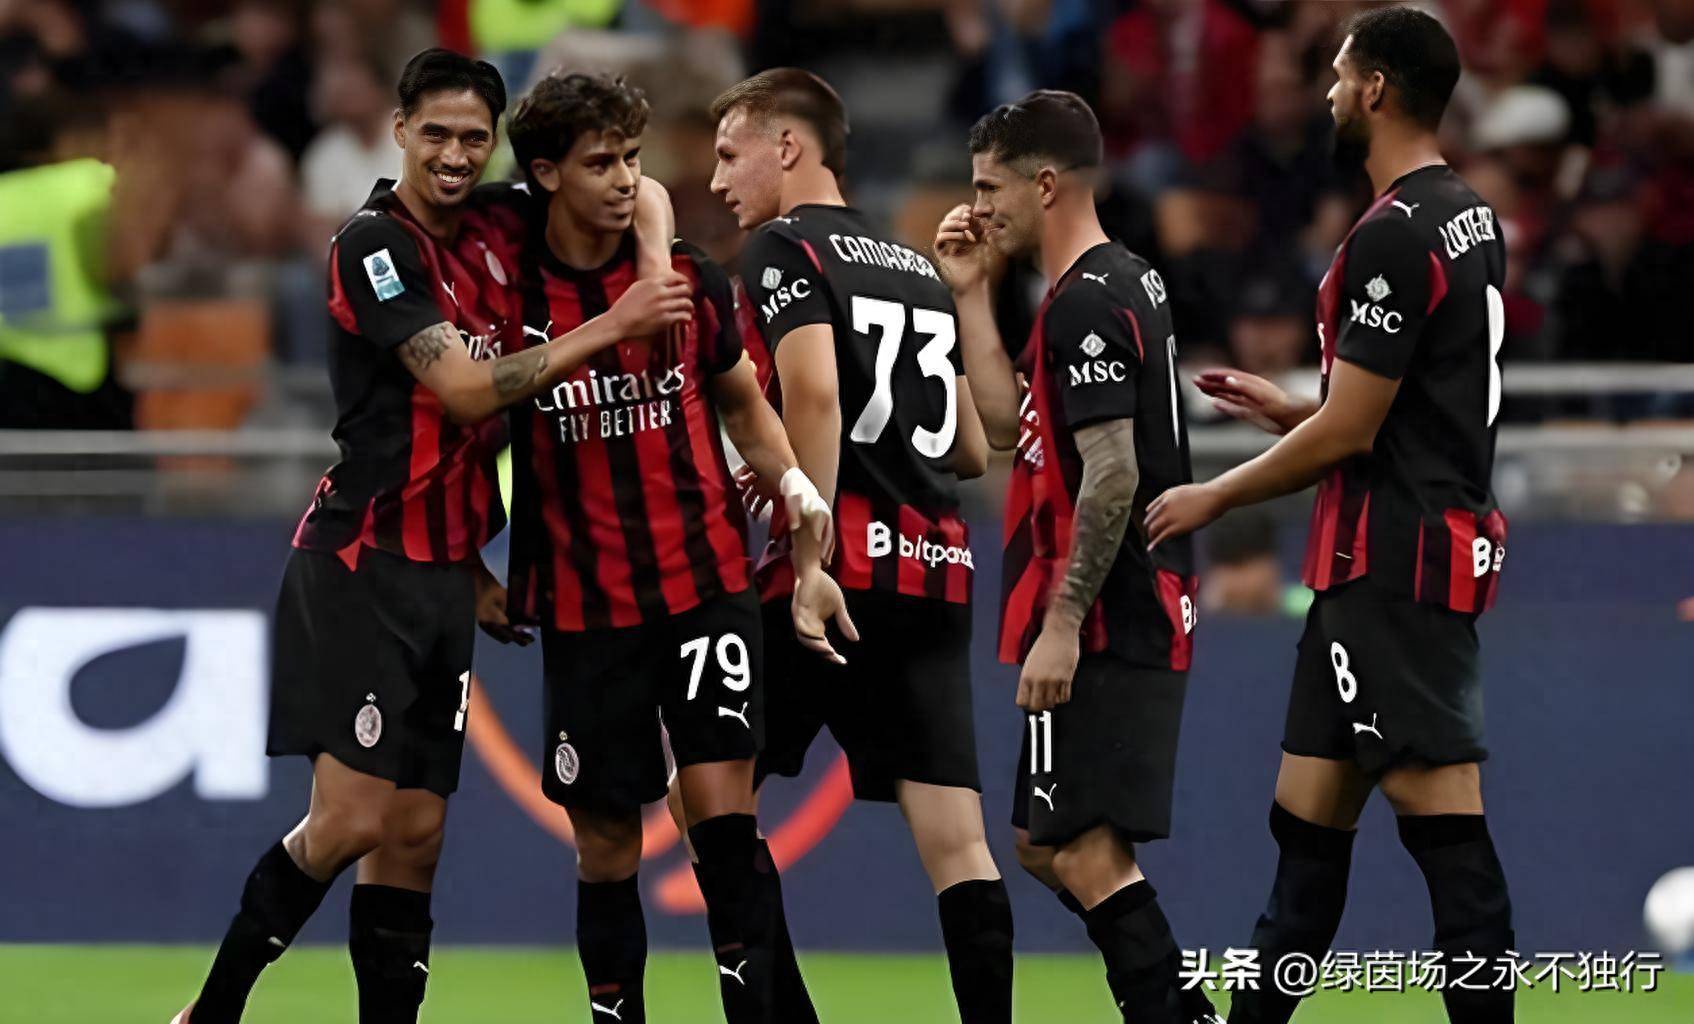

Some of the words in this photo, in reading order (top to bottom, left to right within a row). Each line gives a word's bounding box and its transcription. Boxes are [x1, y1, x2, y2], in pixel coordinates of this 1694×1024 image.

[761, 277, 811, 324] MSC
[1351, 299, 1403, 334] MSC
[850, 295, 957, 459] 73
[1068, 360, 1126, 387] MSC
[600, 400, 672, 438] BETTER
[680, 633, 751, 701] 79
[1330, 641, 1357, 703] 8
[1029, 710, 1052, 775] 11
